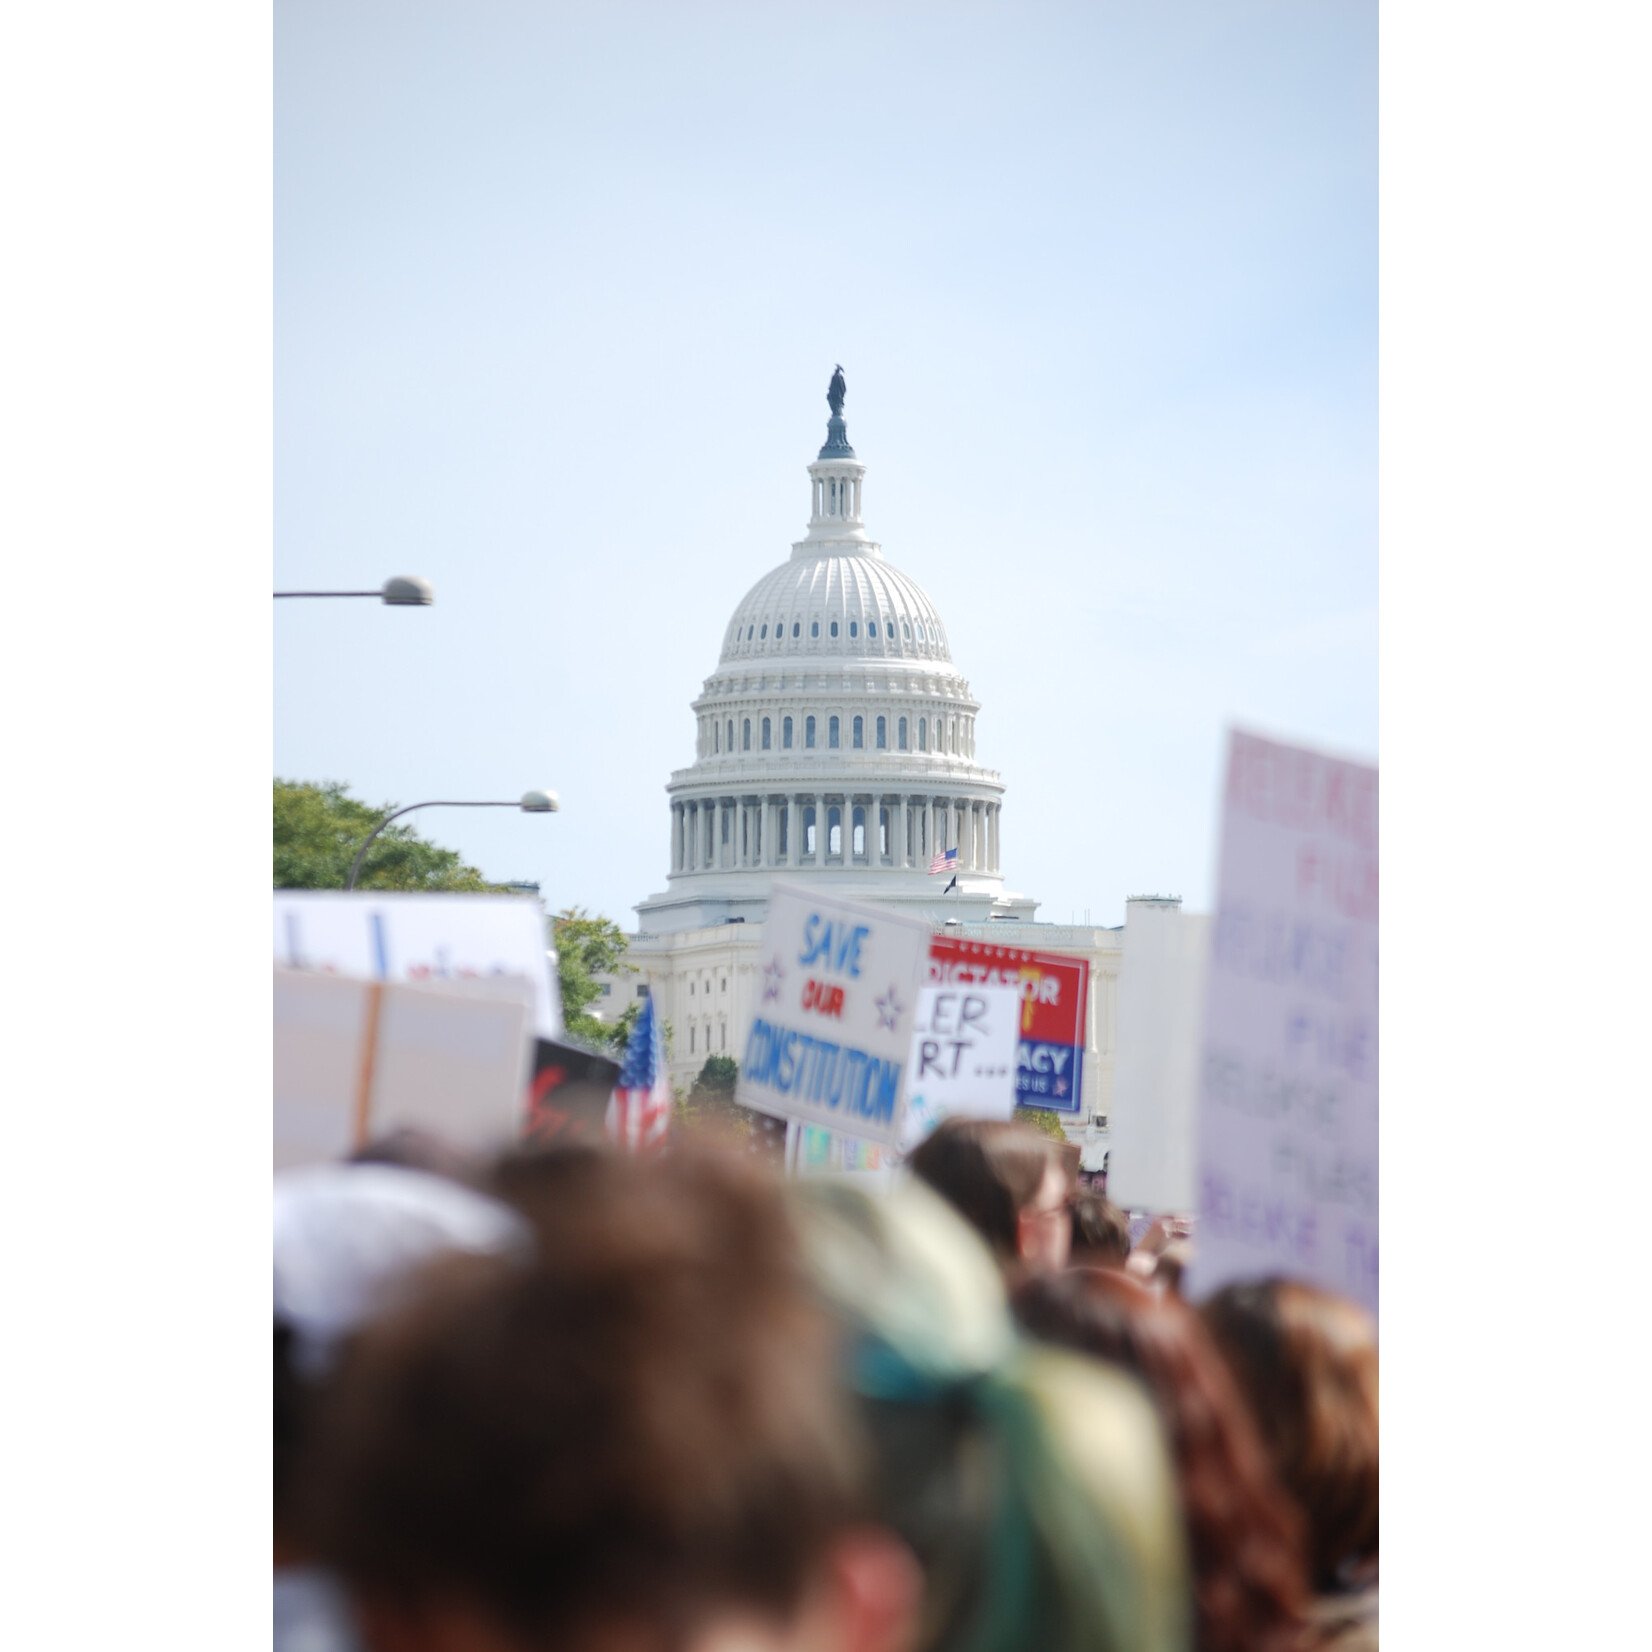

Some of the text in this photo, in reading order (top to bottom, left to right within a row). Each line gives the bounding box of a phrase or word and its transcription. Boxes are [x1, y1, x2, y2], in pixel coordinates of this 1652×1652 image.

[799, 914, 869, 977] SAVE
[802, 978, 846, 1022] OUR
[913, 993, 989, 1036] ER
[744, 1018, 901, 1127] CONSTITUTION
